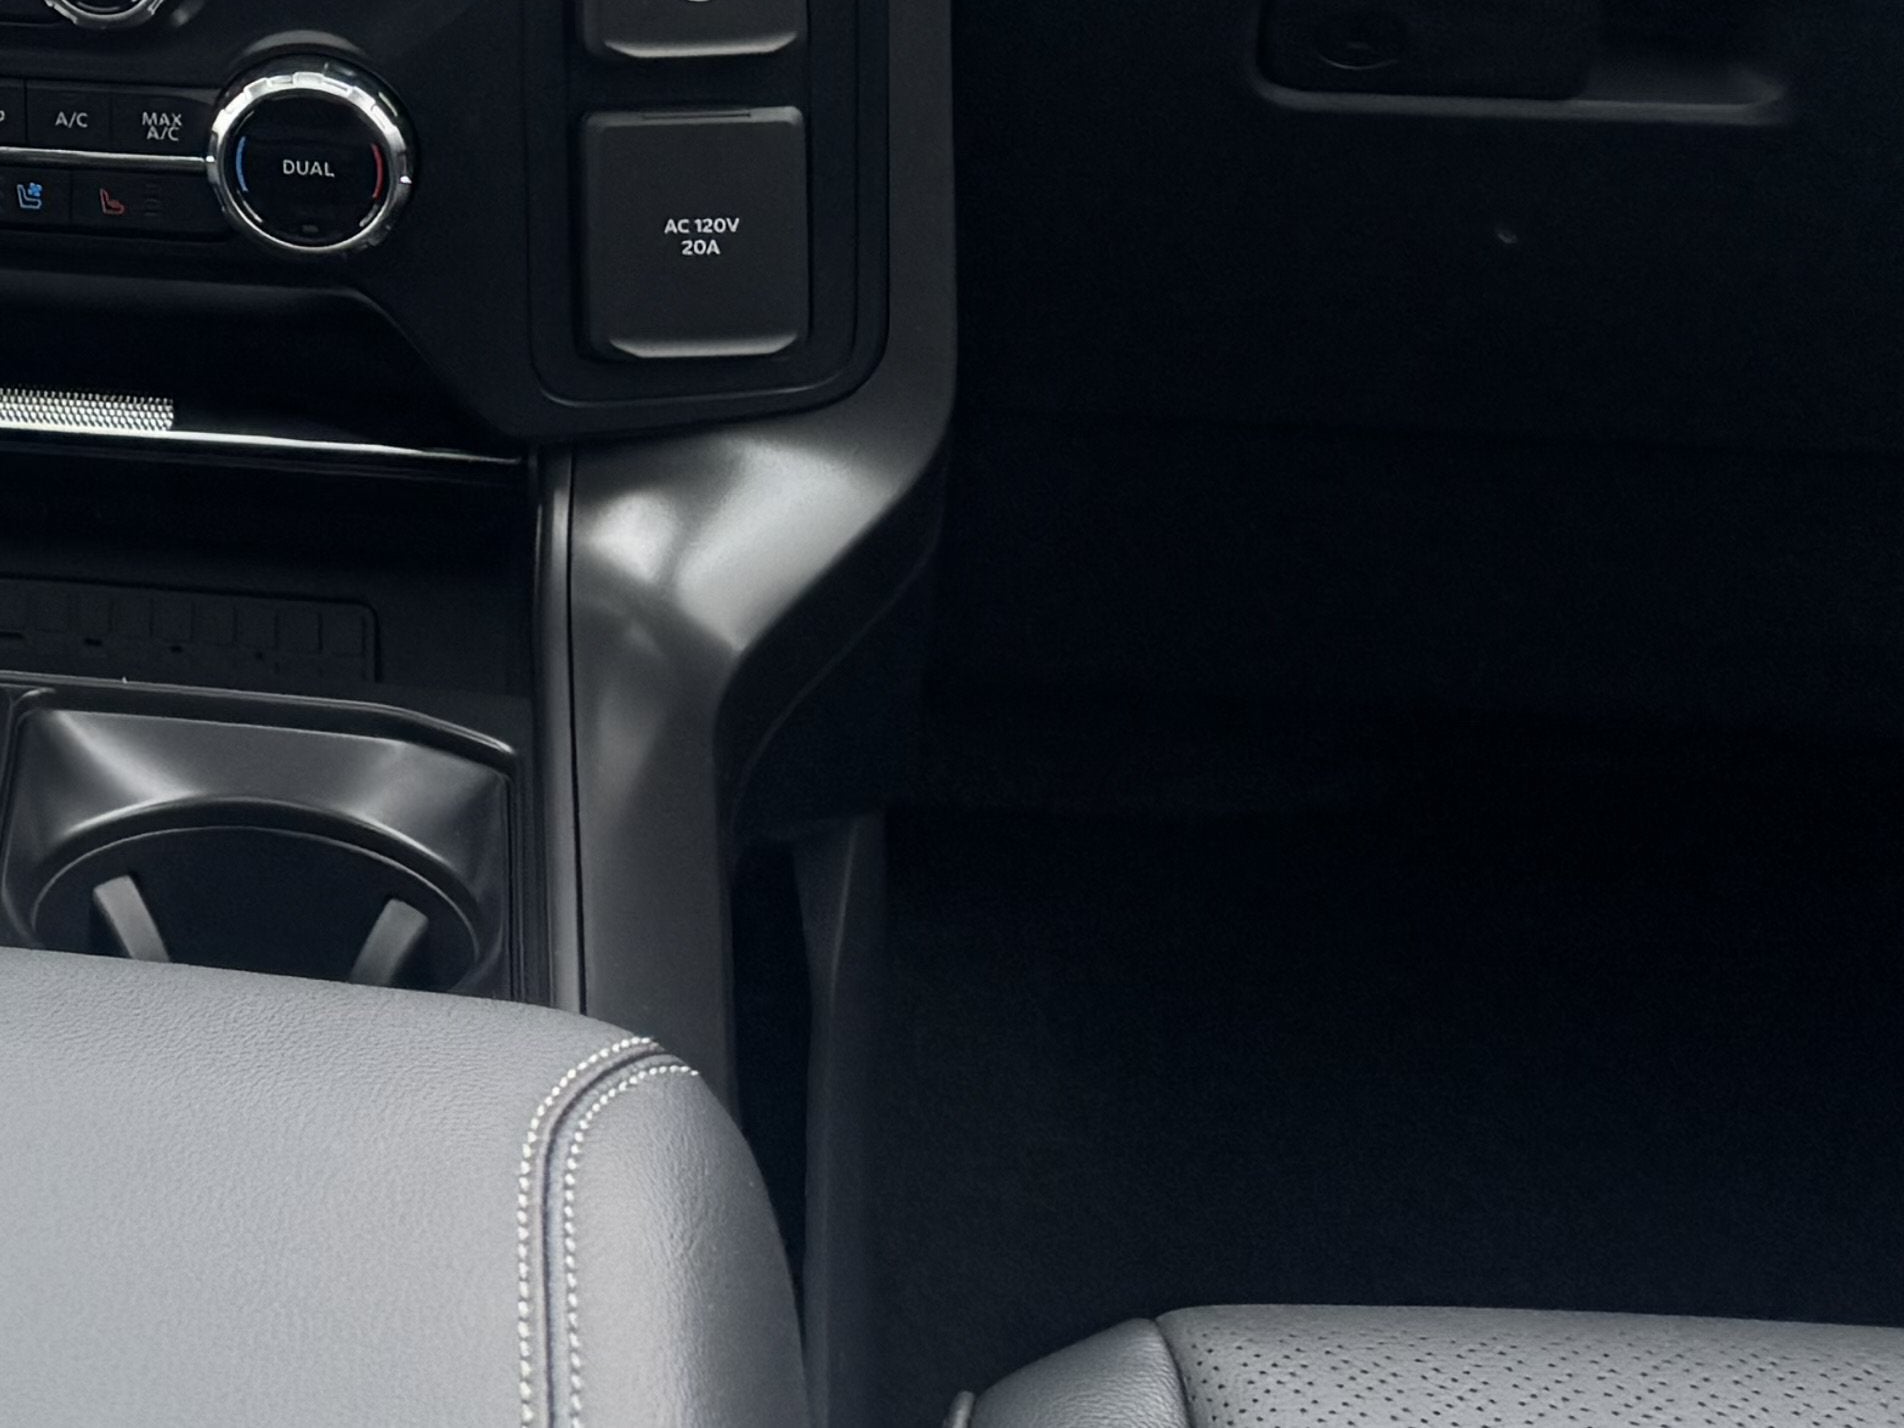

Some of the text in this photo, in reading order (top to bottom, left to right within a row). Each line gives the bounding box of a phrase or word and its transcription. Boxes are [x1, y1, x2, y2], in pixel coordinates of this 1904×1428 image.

[55, 112, 88, 129] A/C
[142, 112, 183, 128] MAX
[146, 126, 180, 142] A/C
[282, 159, 335, 177] DUAL
[664, 217, 740, 234] AC 120V
[681, 240, 720, 255] 20A
